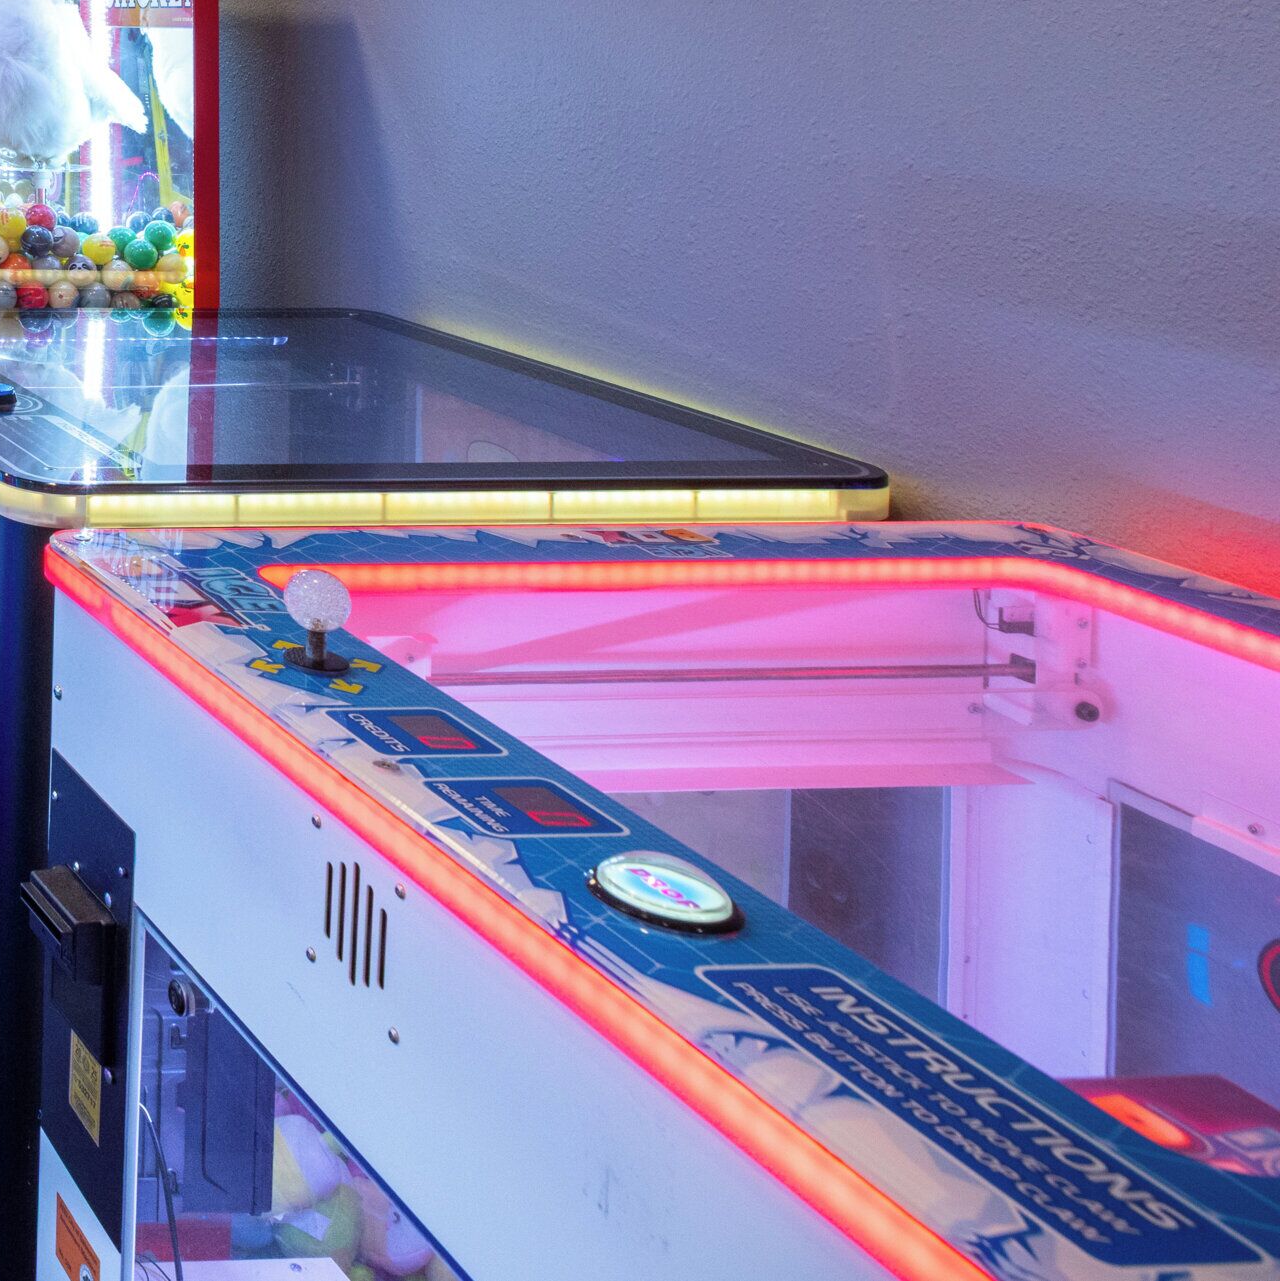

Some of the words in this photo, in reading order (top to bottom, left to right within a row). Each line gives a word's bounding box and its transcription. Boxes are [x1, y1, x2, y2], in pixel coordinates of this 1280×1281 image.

[188, 567, 291, 613] ICE
[347, 713, 412, 753] CREDITS
[432, 782, 511, 834] REMAINING
[473, 795, 513, 819] TIME
[731, 981, 811, 1032] PRESS
[802, 1031, 905, 1098] BUTTON
[901, 1098, 940, 1125] TO
[935, 1125, 1021, 1181] DROP
[1015, 1181, 1113, 1245] CLAW
[773, 986, 825, 1017] USE
[816, 1017, 932, 1090] JOYSTICK
[928, 1092, 968, 1117] TO
[961, 1117, 1050, 1172] MOVE
[1043, 1173, 1142, 1236] CLAW
[809, 985, 1197, 1231] INSTRUCTIONS
